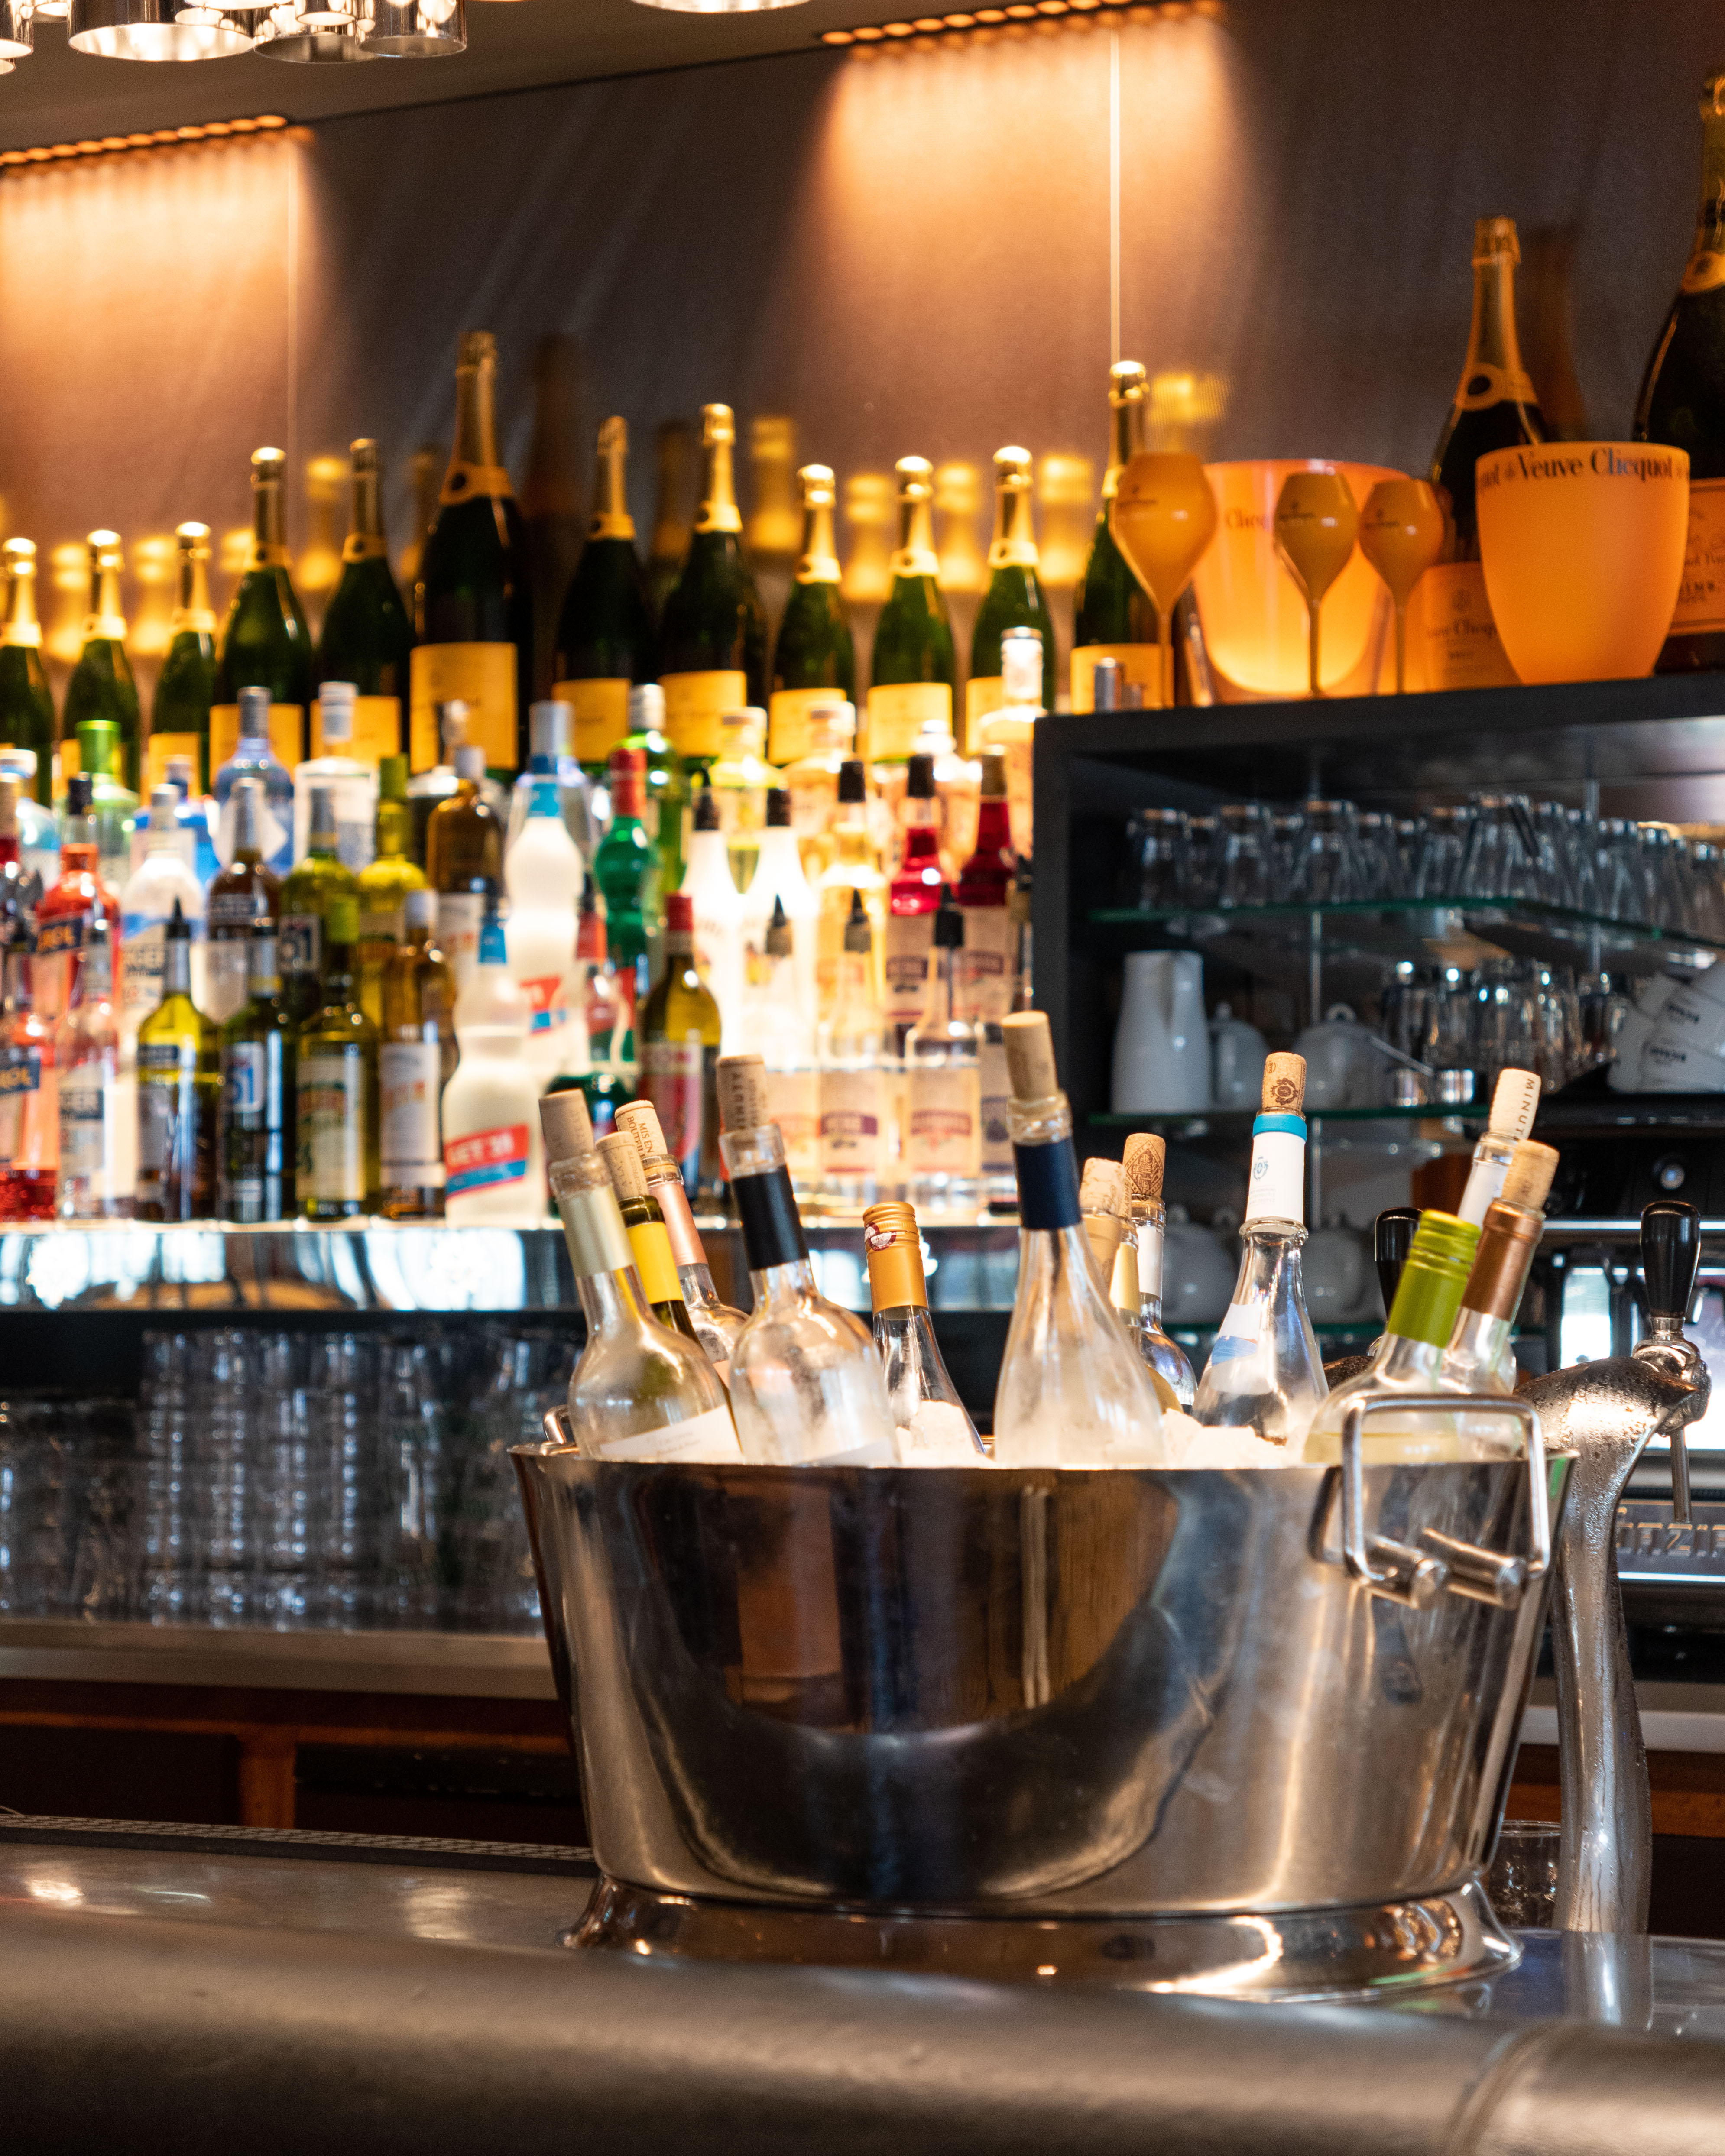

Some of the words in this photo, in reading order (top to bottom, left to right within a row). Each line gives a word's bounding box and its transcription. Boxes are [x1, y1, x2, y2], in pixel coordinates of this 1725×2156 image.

[1517, 452, 1583, 481] Veuve
[1590, 447, 1673, 482] Clicquot
[638, 1122, 650, 1139] MIS
[644, 1140, 654, 1154] EN
